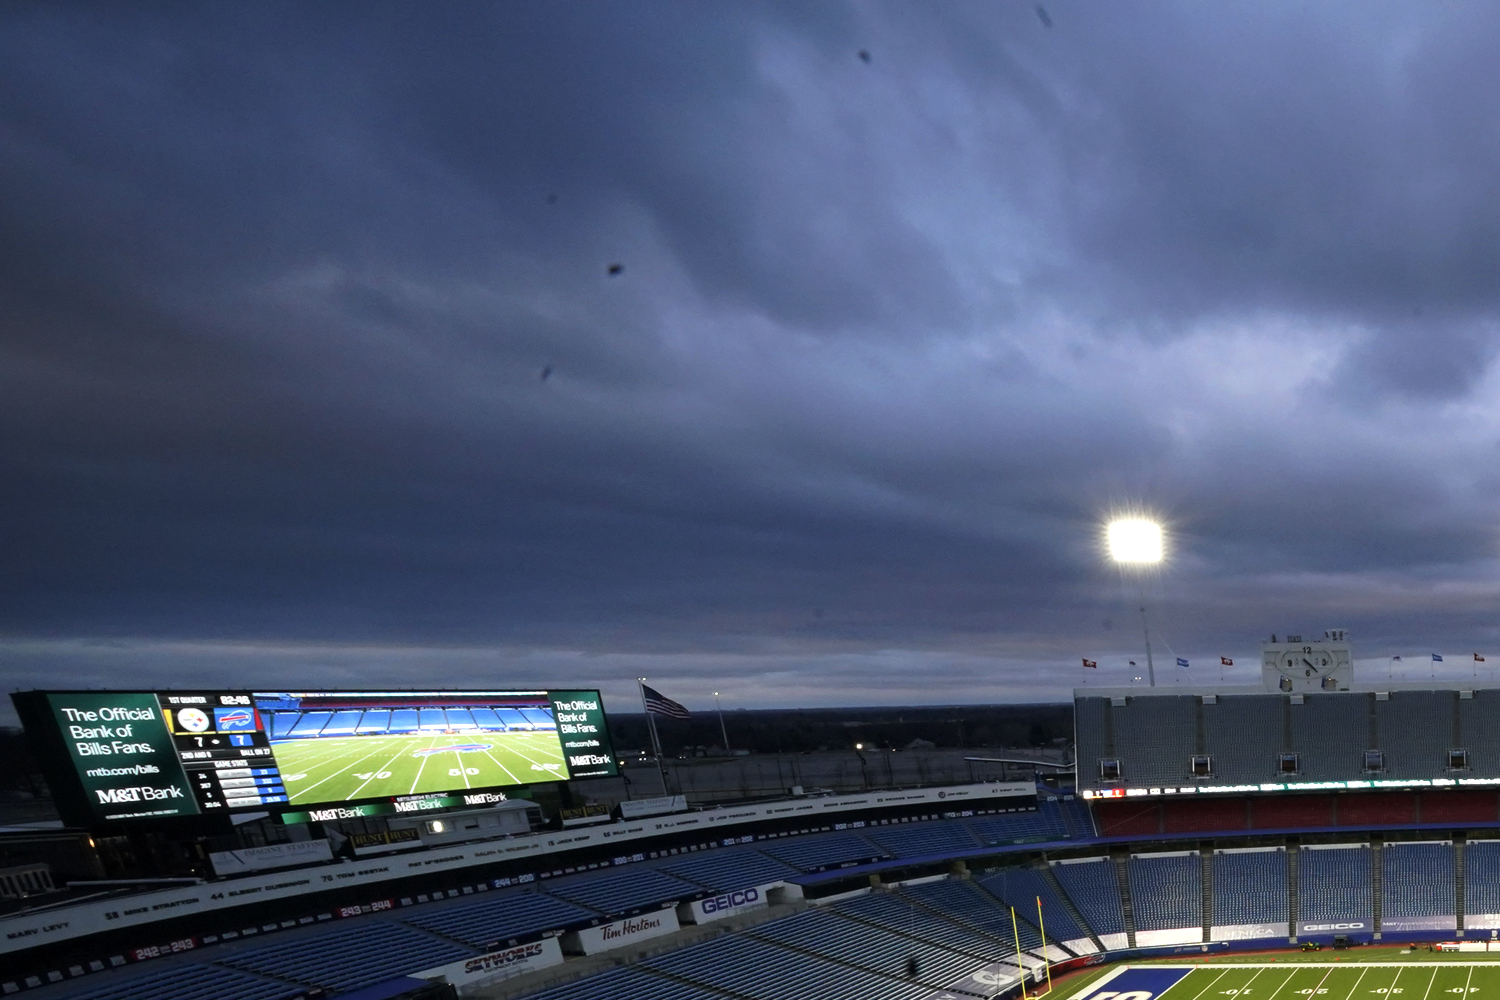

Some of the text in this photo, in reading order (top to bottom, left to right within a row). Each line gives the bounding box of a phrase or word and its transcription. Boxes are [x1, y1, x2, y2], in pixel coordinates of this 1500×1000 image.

[1302, 646, 1312, 654] 12
[1322, 658, 1326, 666] 3
[168, 696, 207, 704] 1ST QUARTER
[554, 700, 598, 711] The Official
[61, 706, 156, 722] The Official
[558, 712, 588, 722] Bank of
[69, 724, 133, 740] Bank of
[560, 724, 598, 734] Bills Fans.
[194, 736, 203, 748] 7
[236, 735, 244, 746] 7
[76, 740, 156, 756] Bills Fans.
[570, 754, 611, 766] M&T Bank
[86, 764, 160, 778] mtb.com/bills
[94, 785, 184, 804] M&T Bank
[464, 792, 508, 805] M&T Bank
[394, 799, 443, 812] M&T Bank
[586, 805, 606, 814] HUNT
[308, 806, 365, 822] M&T Bank
[562, 808, 584, 818] HUNT
[354, 834, 384, 846] HUNT
[388, 829, 416, 840] HUNT
[336, 872, 356, 880] TOM
[518, 873, 534, 884] 200
[494, 877, 511, 888] 244
[210, 892, 224, 900] 44
[228, 886, 262, 897] ELBERT
[124, 906, 149, 916] MIKE
[152, 898, 200, 911] STRATTON
[371, 900, 392, 912] 244
[702, 888, 759, 914] GEICO
[340, 906, 362, 917] 243
[6, 922, 69, 939] MARV LEVY
[600, 918, 661, 941] Tim Hortons
[1224, 928, 1275, 938] SENECA
[1304, 922, 1364, 932] GEICO
[170, 938, 194, 953] 243
[135, 946, 160, 960] 242
[464, 942, 542, 974] SKYWORKS
